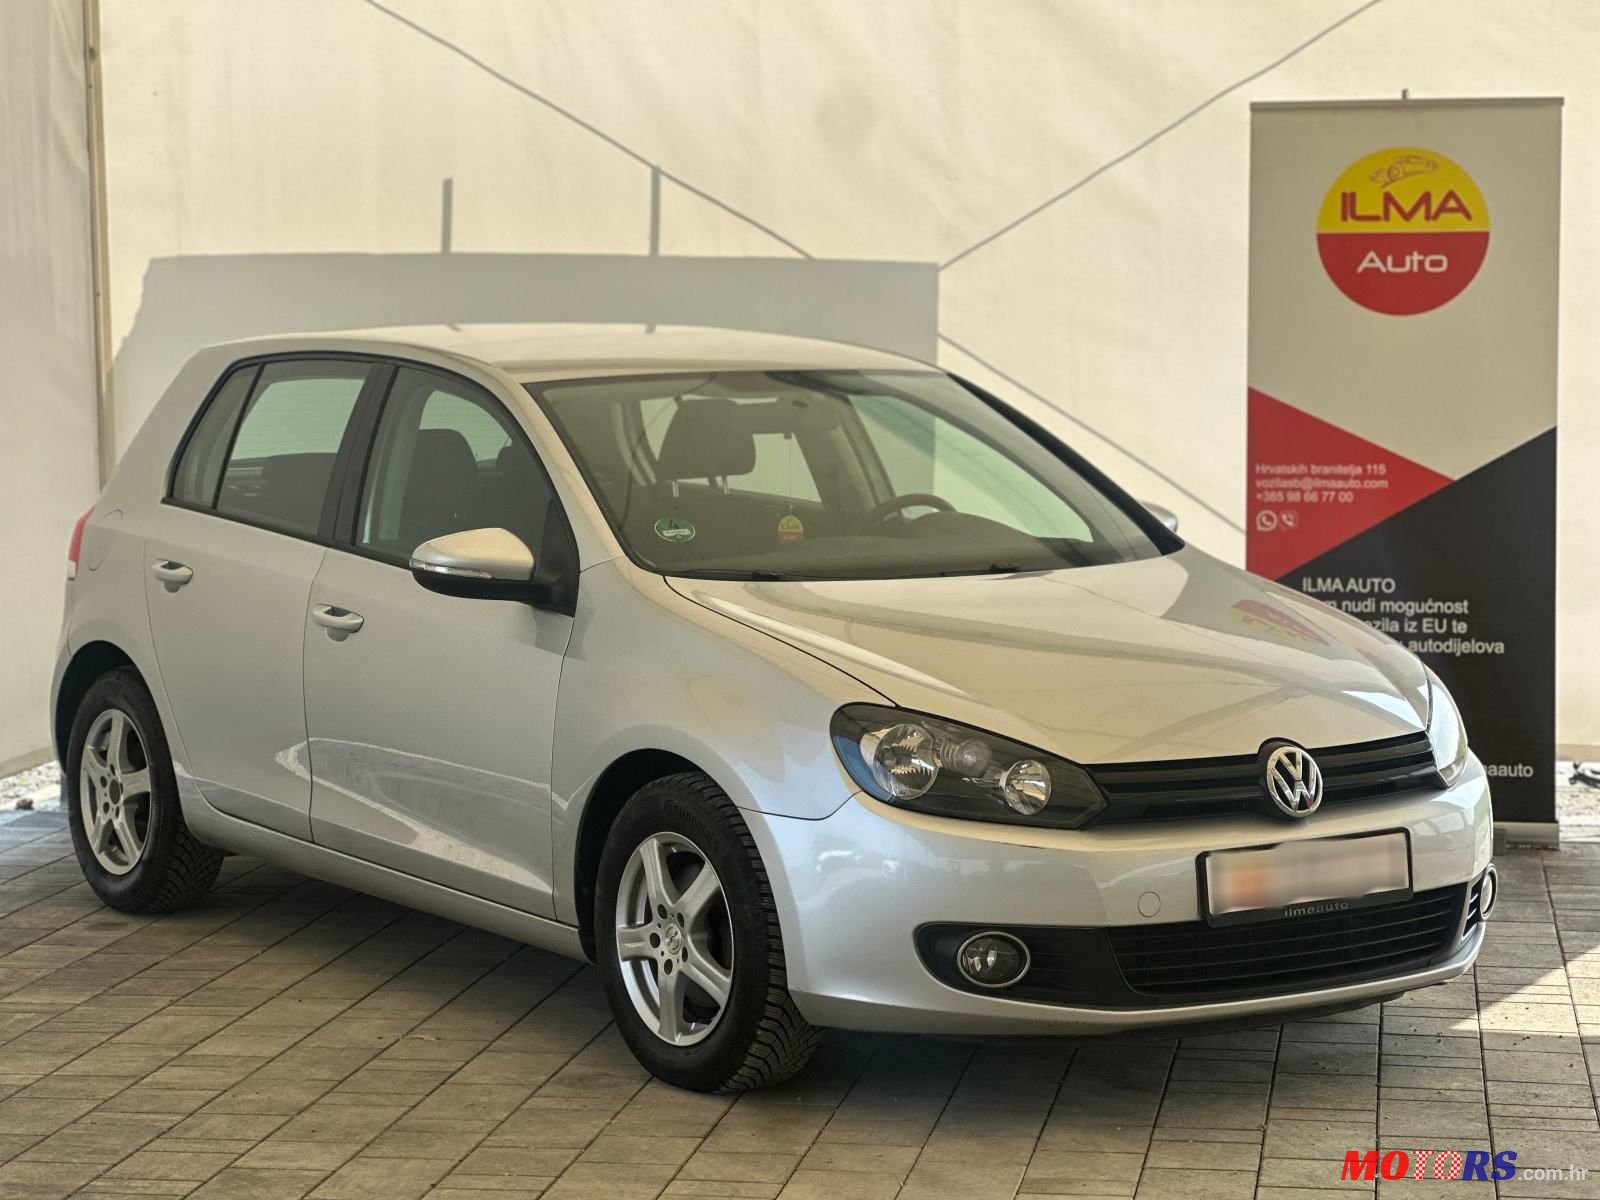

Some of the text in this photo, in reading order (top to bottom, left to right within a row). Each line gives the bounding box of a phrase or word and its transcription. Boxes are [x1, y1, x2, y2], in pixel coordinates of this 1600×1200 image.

[1340, 190, 1472, 222] ILMA
[1356, 250, 1449, 273] Auto
[1366, 465, 1387, 475] 115
[1321, 491, 1336, 503] 77
[1302, 577, 1396, 593] ILMA AUTO
[1342, 598, 1376, 612] nudi
[1380, 598, 1469, 617] mogućnost
[1404, 618, 1418, 633] iz
[1422, 618, 1448, 633] EU
[1452, 618, 1468, 634] te
[1407, 638, 1505, 656] autodijelova
